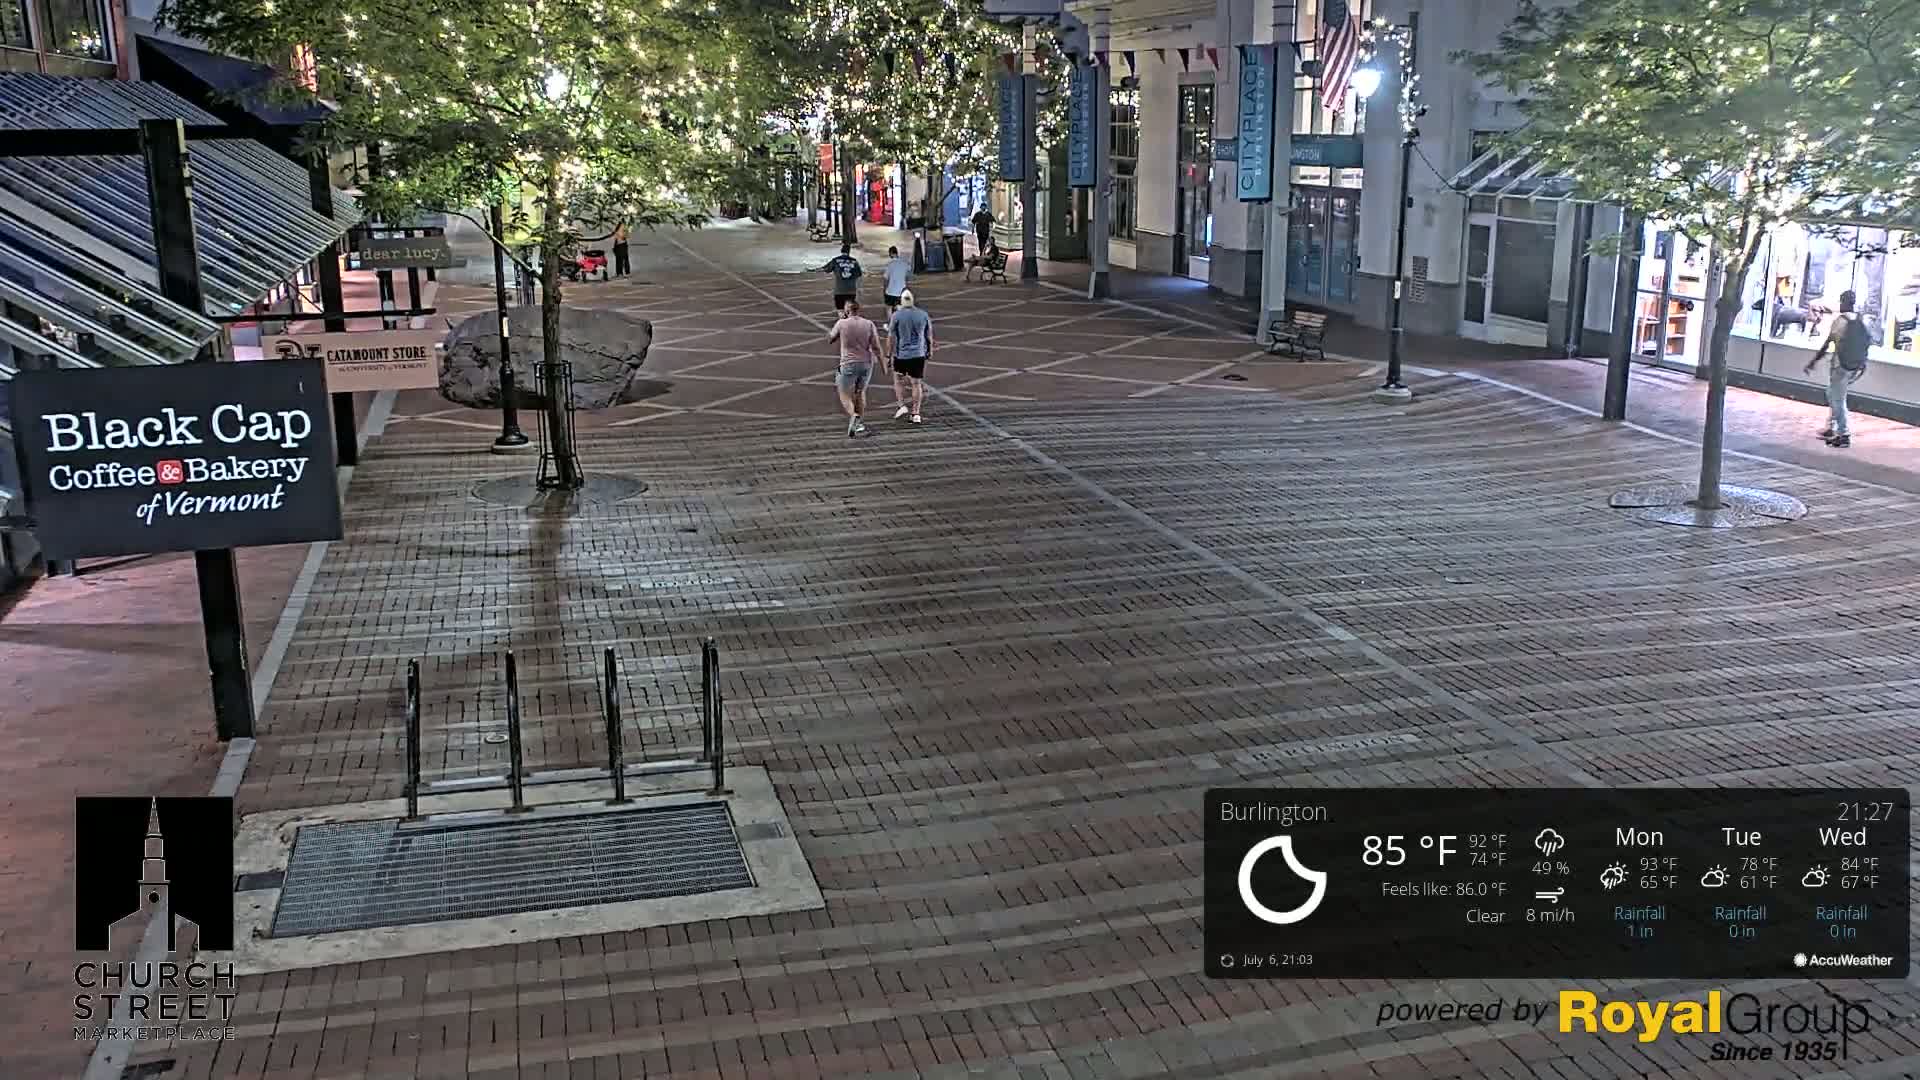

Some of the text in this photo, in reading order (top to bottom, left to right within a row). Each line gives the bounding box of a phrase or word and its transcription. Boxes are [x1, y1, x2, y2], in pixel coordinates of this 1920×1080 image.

[1071, 68, 1082, 179] CITYPLACE
[1240, 51, 1257, 191] CITYPLACE
[1254, 64, 1266, 176] BURLINGTON
[362, 247, 446, 261] dear lucy.
[327, 347, 389, 362] CATAMOUNT
[393, 346, 426, 359] STORE
[42, 404, 311, 451] Black Cap
[50, 462, 156, 491] Coffee
[184, 456, 309, 482] Bakery
[137, 484, 284, 525] of Vermont
